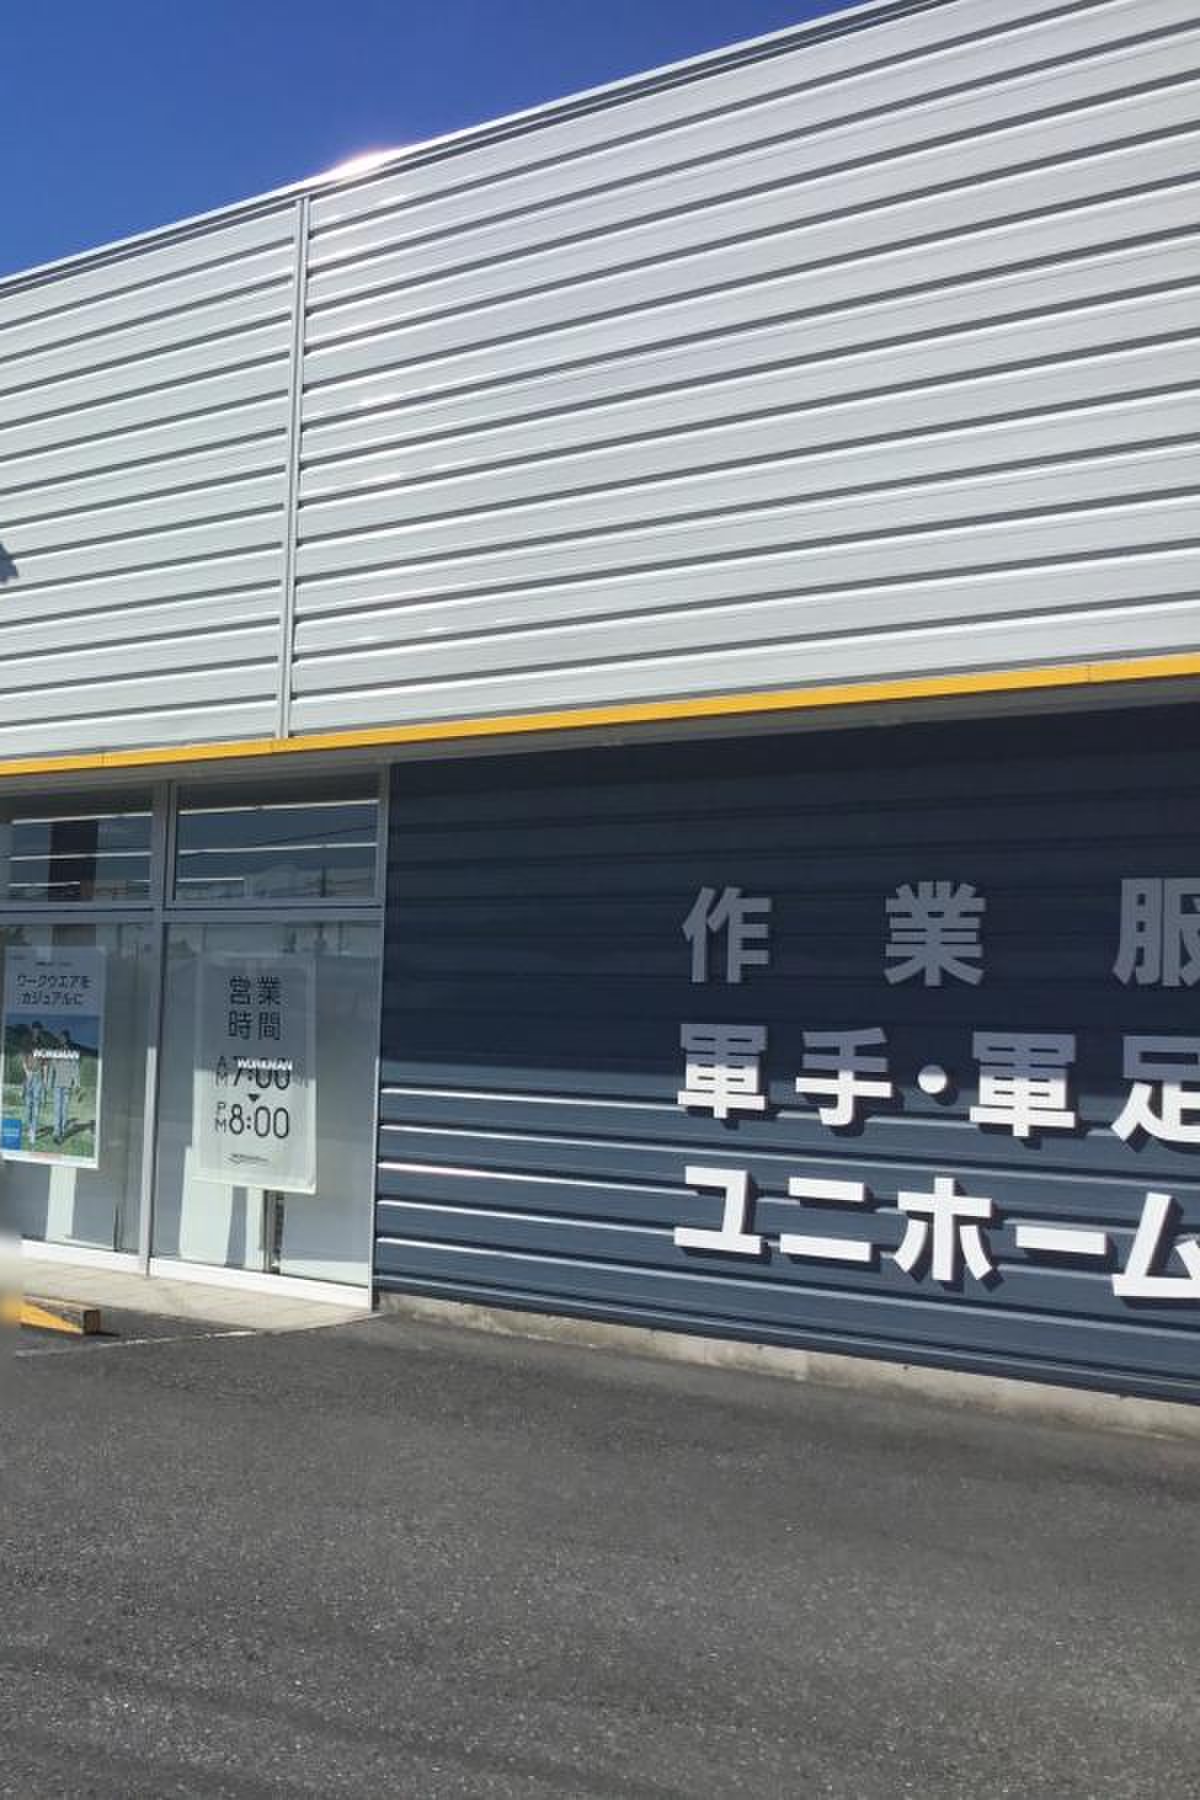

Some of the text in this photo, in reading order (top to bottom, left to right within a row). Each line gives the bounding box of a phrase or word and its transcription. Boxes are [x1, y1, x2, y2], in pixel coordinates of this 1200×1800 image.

[228, 976, 282, 1006] 営業
[227, 1011, 281, 1041] 時間
[677, 1024, 1200, 1143] 軍手・軍足
[228, 1104, 289, 1139] 8:00
[674, 1166, 1200, 1297] ユニホーム
